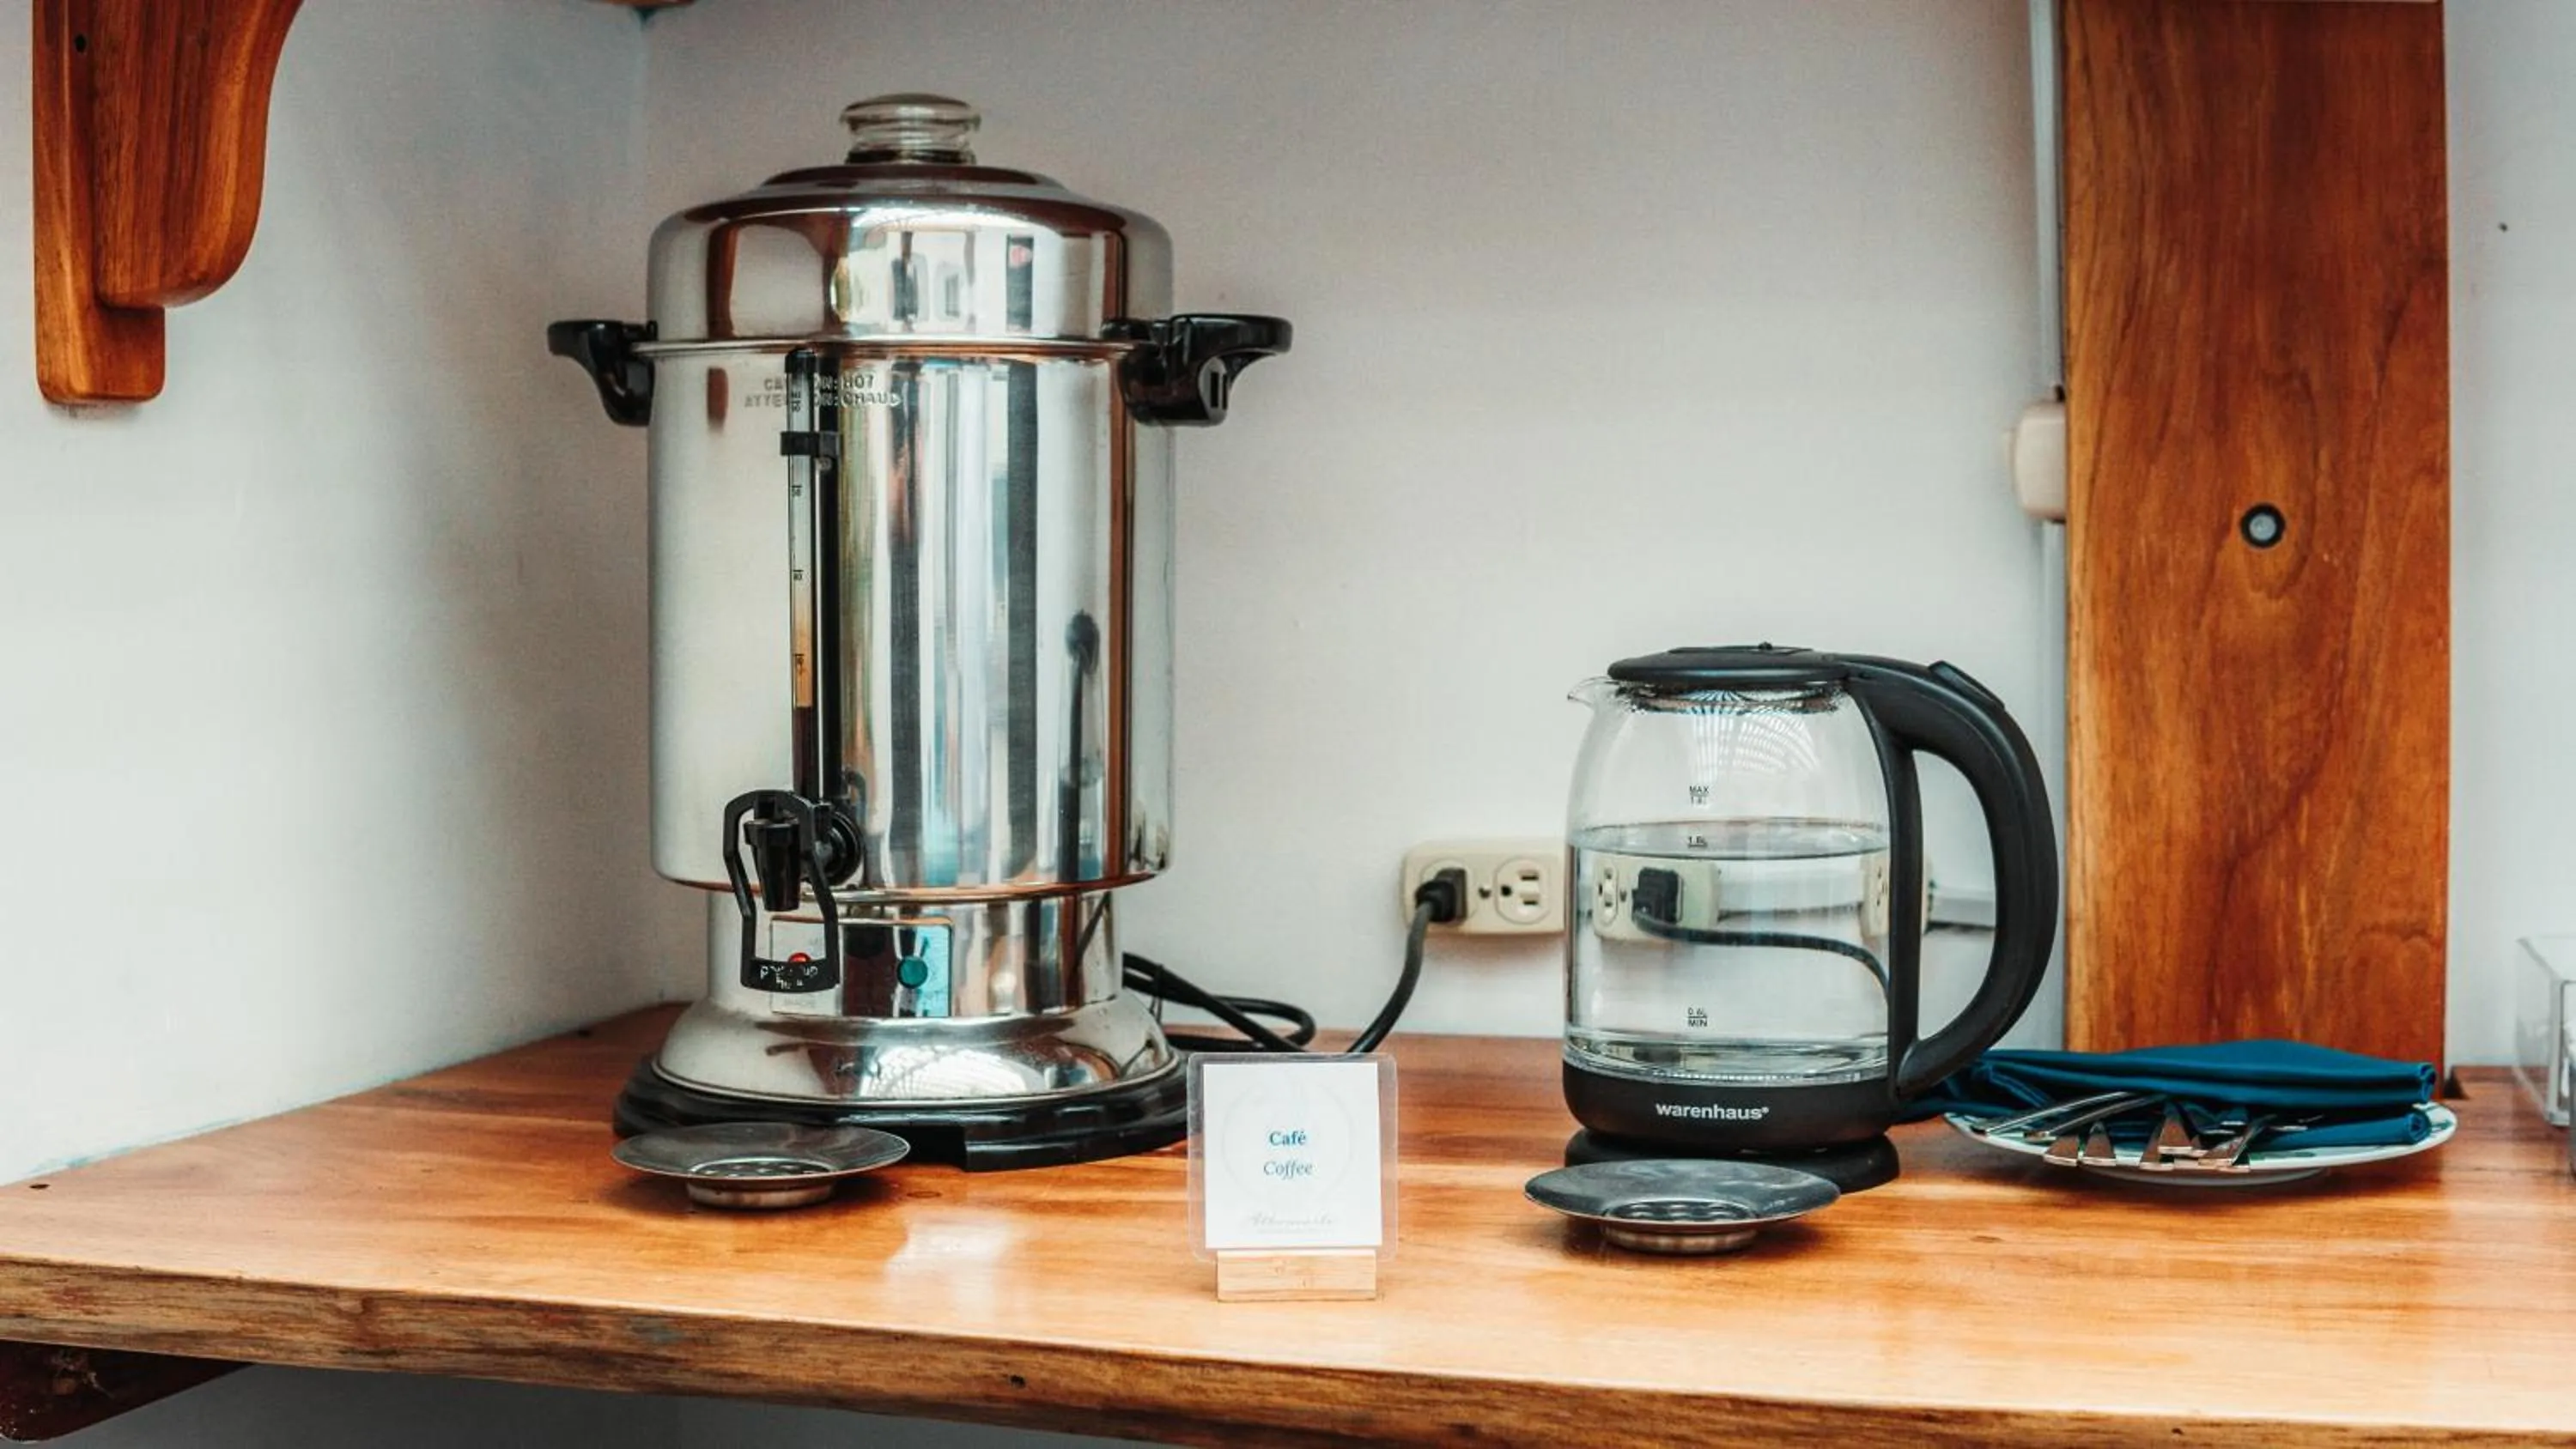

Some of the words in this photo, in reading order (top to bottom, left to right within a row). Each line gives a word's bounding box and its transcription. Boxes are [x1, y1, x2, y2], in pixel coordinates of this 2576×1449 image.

[1689, 785, 1710, 794] MAX
[1687, 1019, 1708, 1028] MIN
[1269, 1129, 1307, 1146] Café
[1263, 1160, 1314, 1180] Coffee
